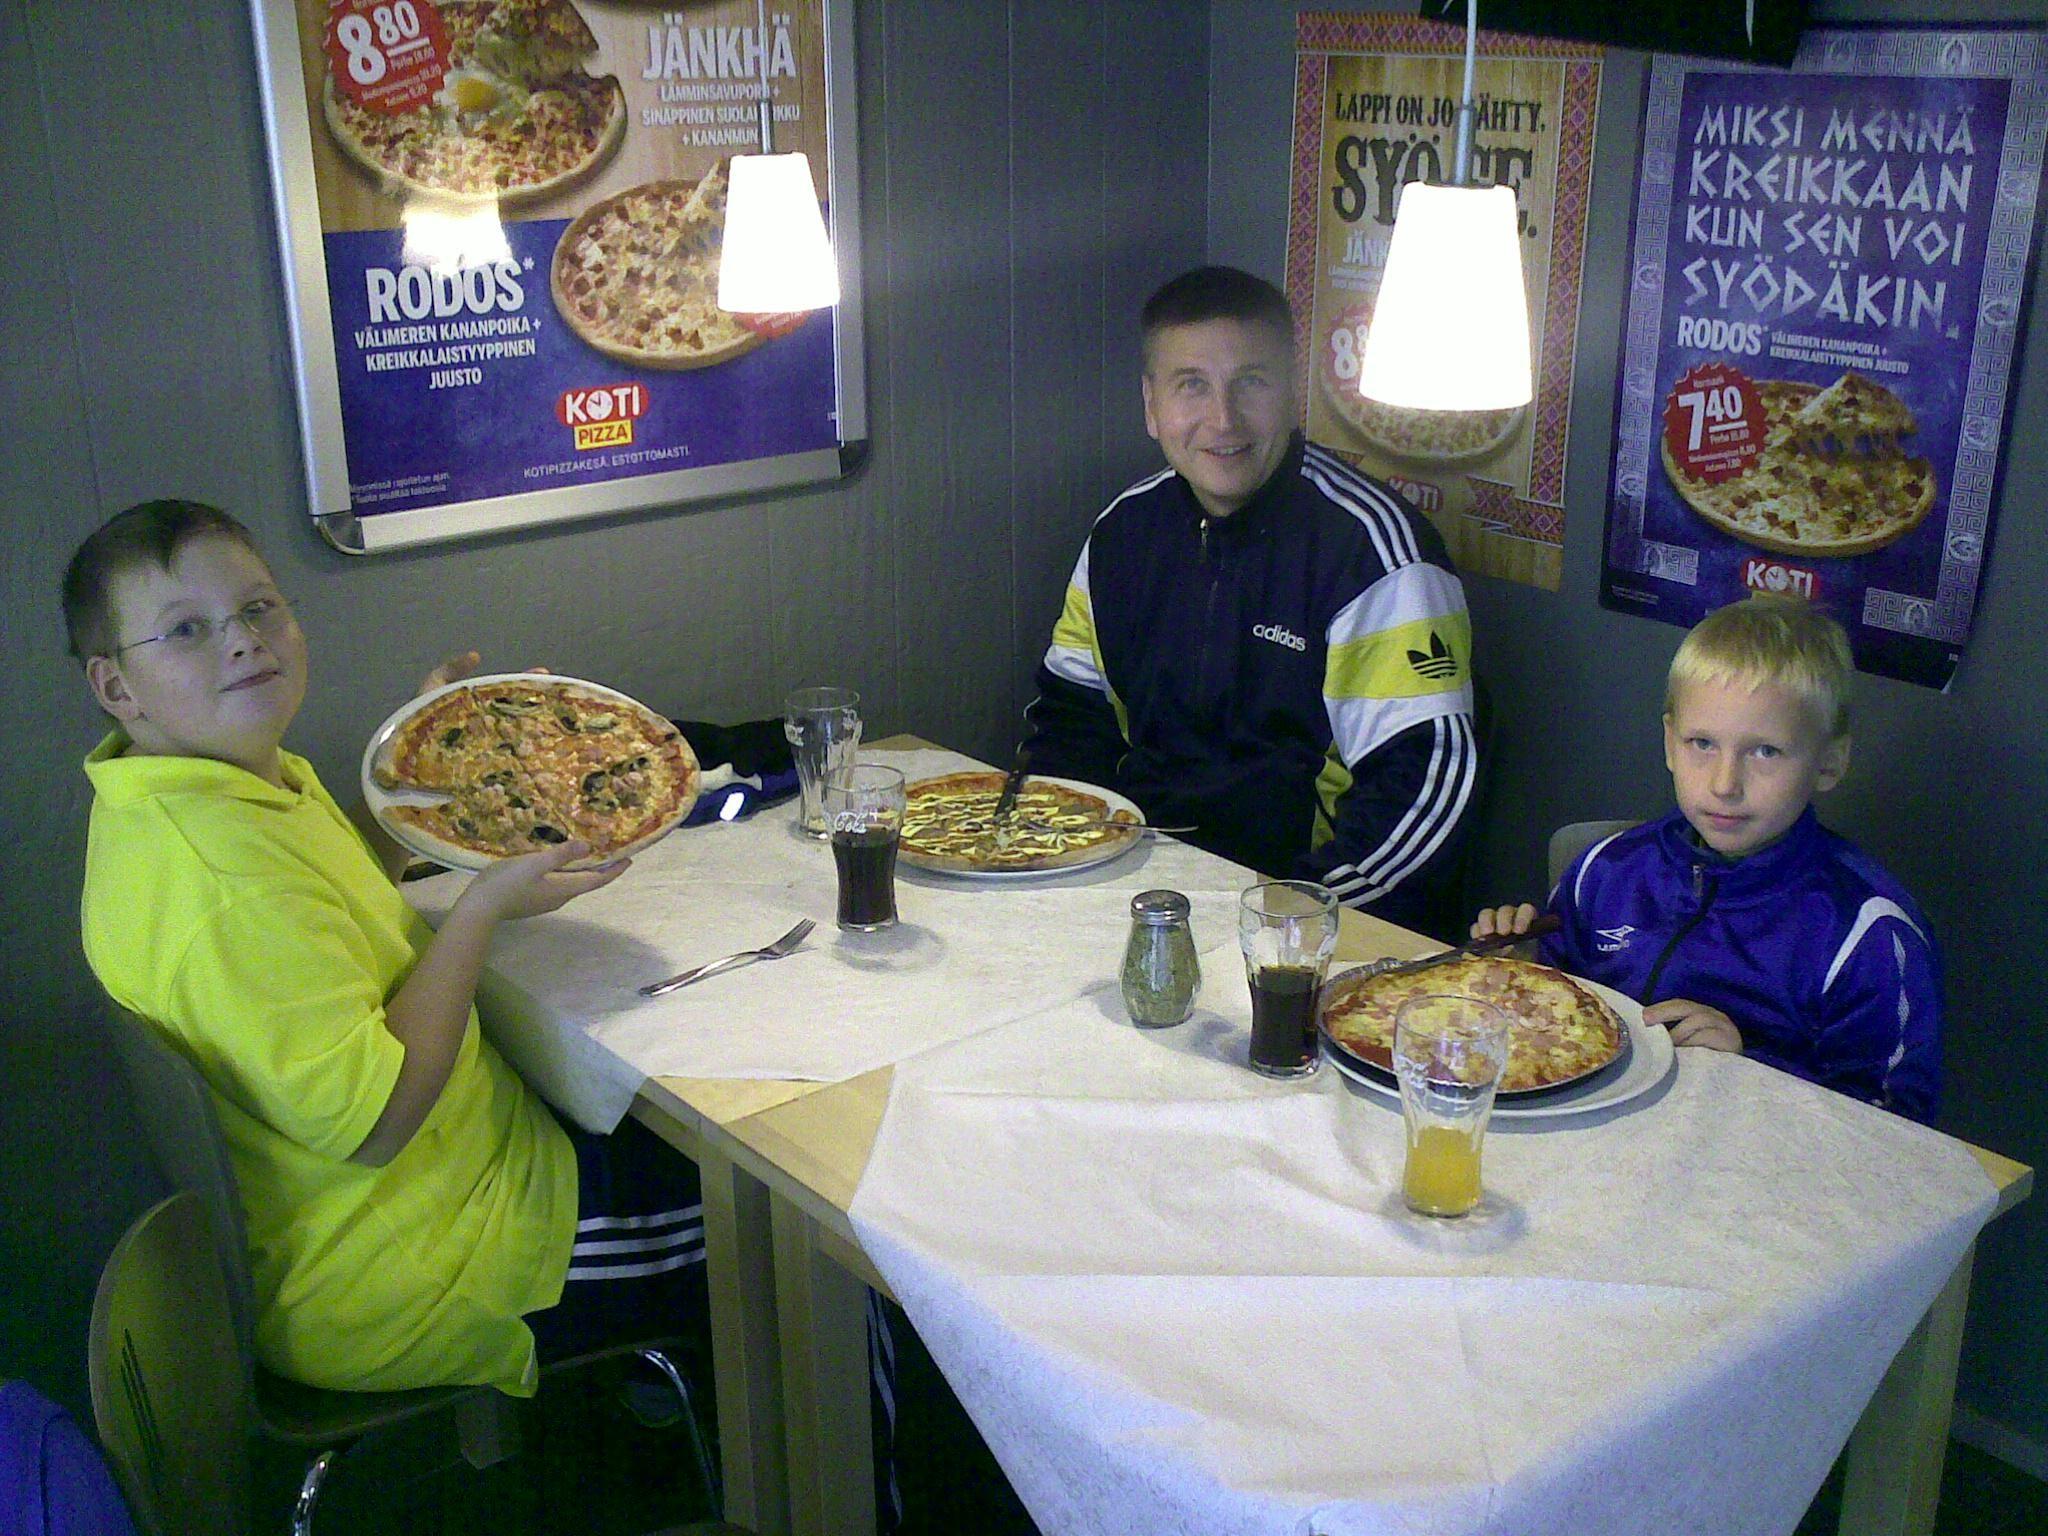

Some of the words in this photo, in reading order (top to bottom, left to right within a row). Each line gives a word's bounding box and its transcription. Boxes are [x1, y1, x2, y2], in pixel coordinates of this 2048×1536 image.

[642, 12, 796, 79] JÄNKHÄ
[1336, 92, 1391, 124] LAPPI
[1396, 94, 1423, 126] ON
[1427, 97, 1454, 128] JO
[1475, 92, 1545, 133] ÄHTY.
[1694, 104, 1804, 148] MIKSI
[1819, 105, 1975, 155] MENNÄ
[691, 127, 759, 148] KANANMUN
[1688, 149, 1973, 213] KREIKKAAN
[1685, 204, 1764, 249] KUN
[1783, 210, 1863, 257] SEN
[1884, 217, 1966, 267] VOI
[1681, 253, 1960, 341] SYÖDÄKIN.
[354, 325, 437, 349] VÄLIMEREN
[440, 316, 531, 342] KANANPOIKA
[366, 338, 536, 373] KREIKKALAISTYYPPINEN
[429, 367, 483, 390] JUUSTO
[565, 385, 640, 424] KOTI
[578, 423, 629, 445] PIZZA
[1746, 560, 1814, 599] KOTI
[1252, 623, 1307, 652] adidas
